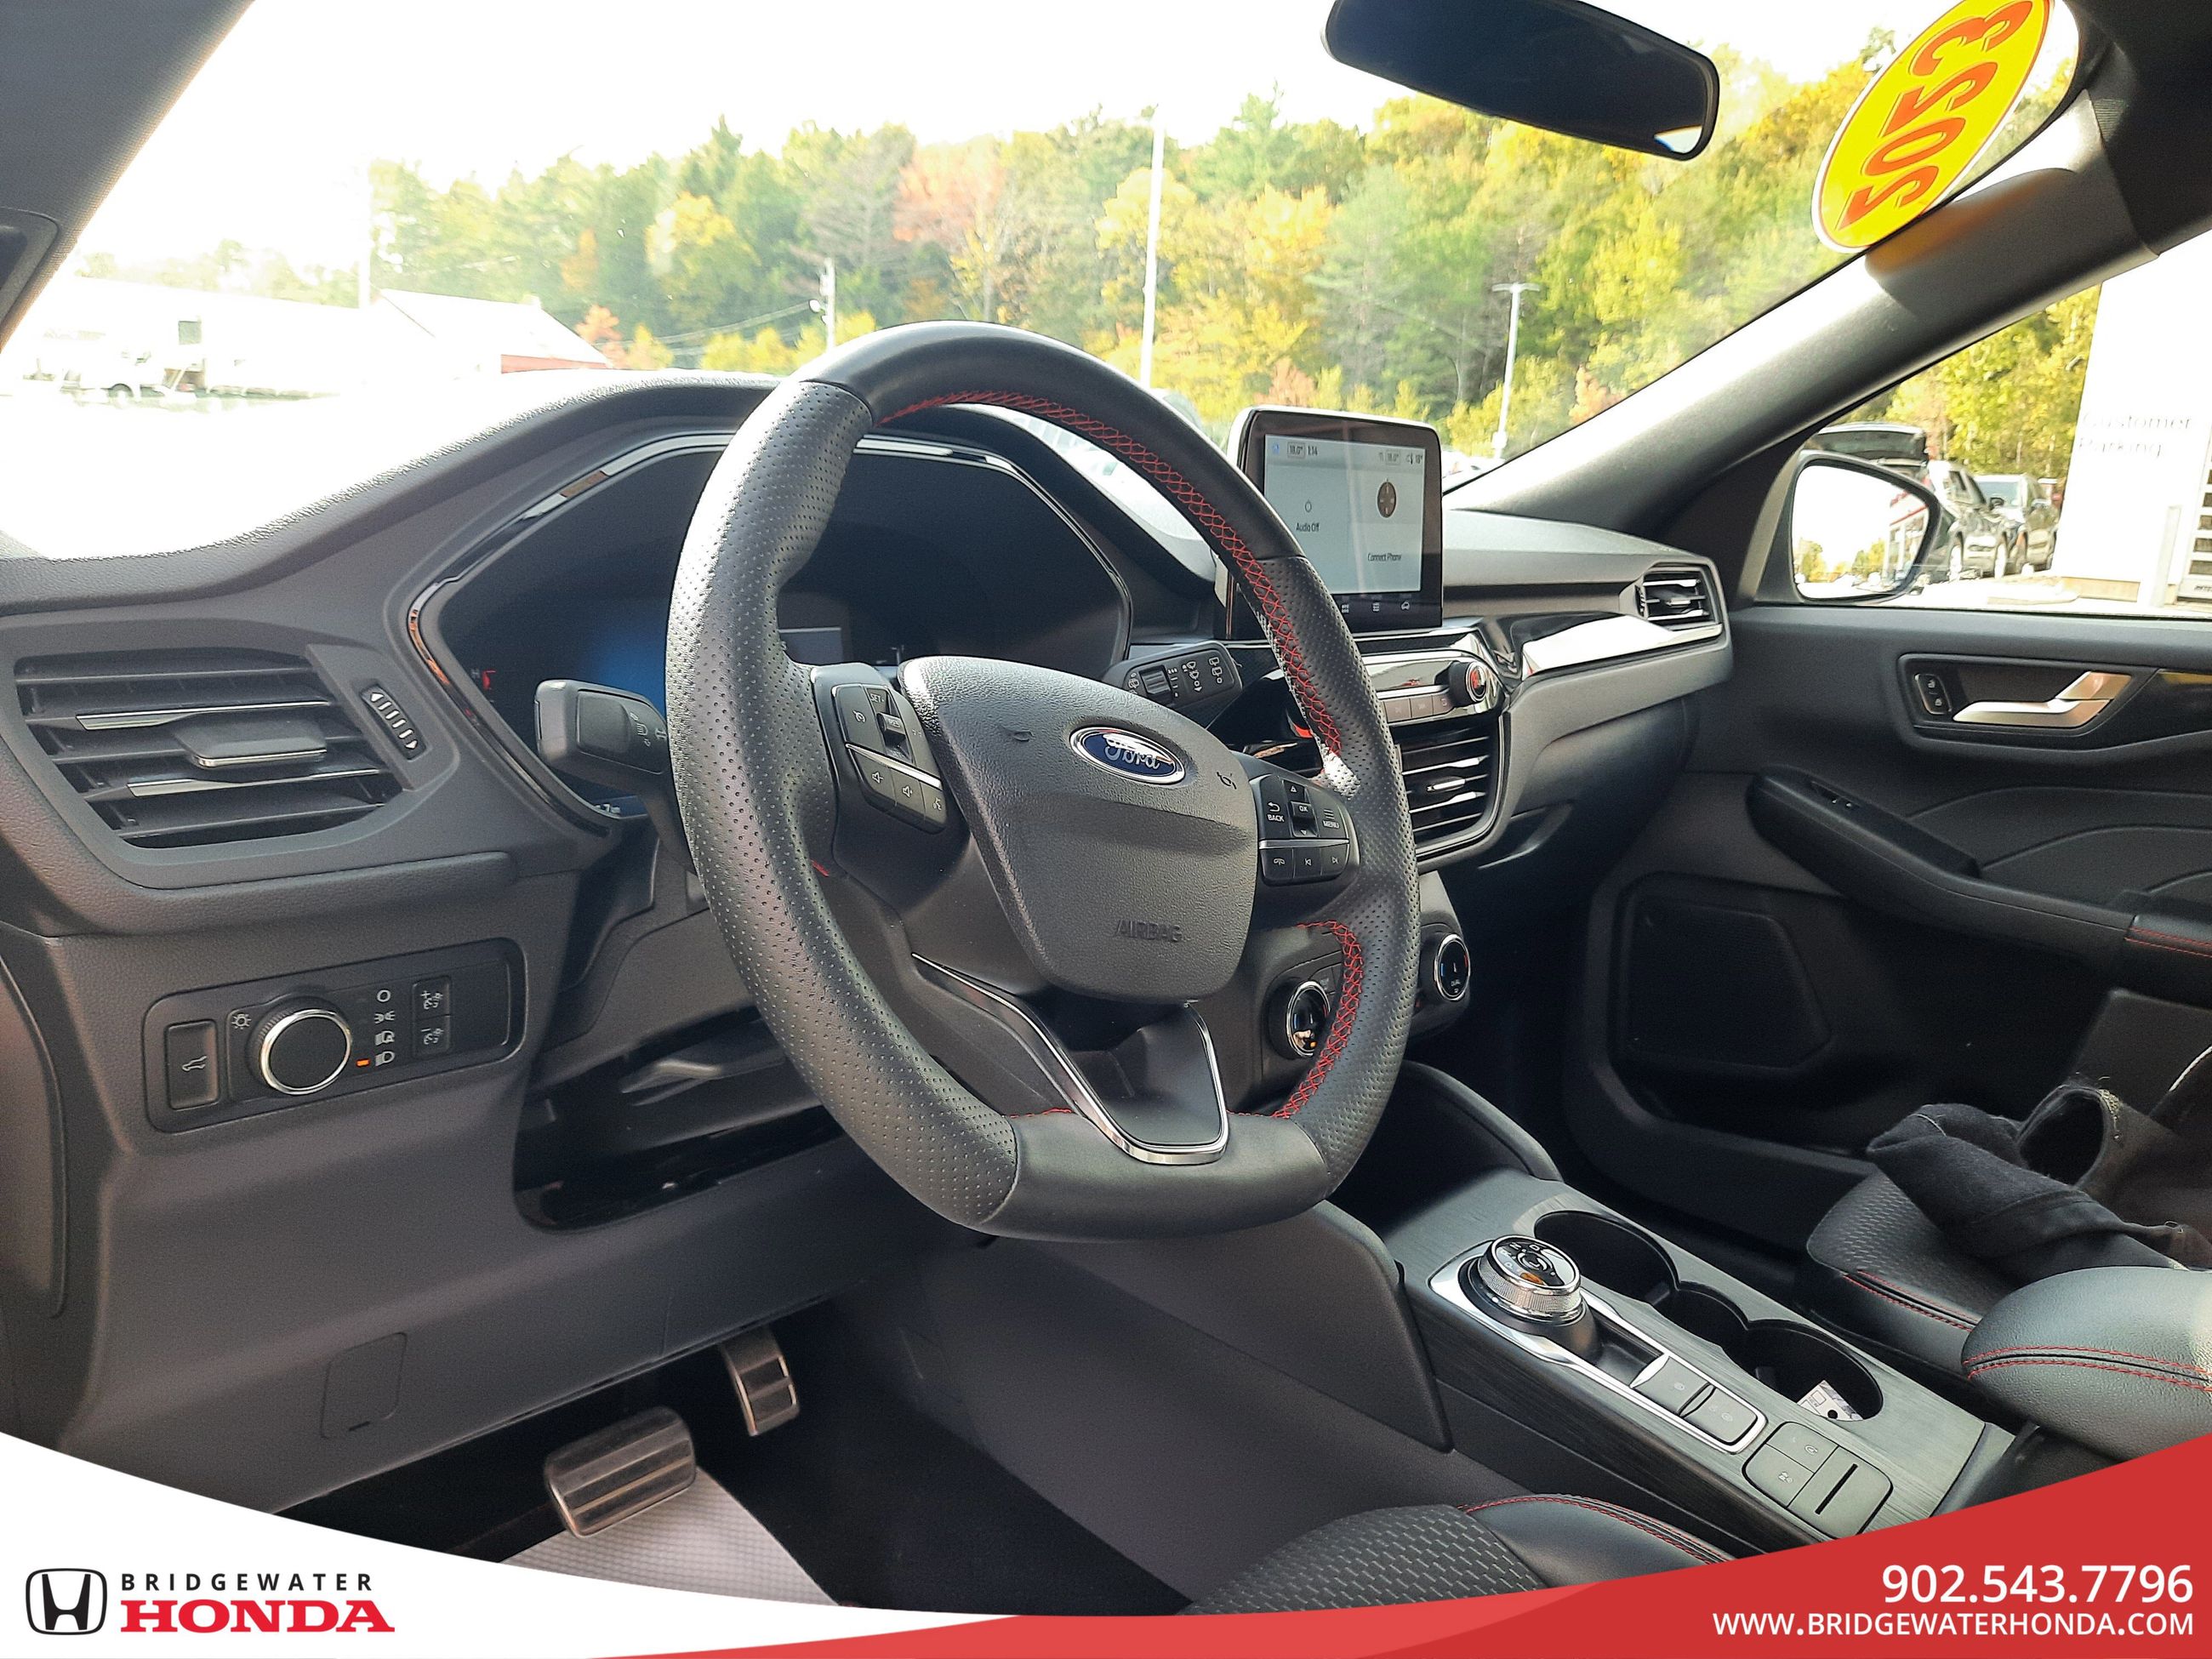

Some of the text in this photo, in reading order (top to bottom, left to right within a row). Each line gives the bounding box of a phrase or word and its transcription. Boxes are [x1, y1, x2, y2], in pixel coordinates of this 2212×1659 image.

[1296, 522, 1320, 533] Audio Off
[1367, 551, 1402, 562] Connect Phone
[1103, 733, 1164, 770] Ford
[1267, 813, 1285, 823] BACK
[1322, 819, 1340, 829] MENU
[1113, 918, 1183, 943] AIRBAG
